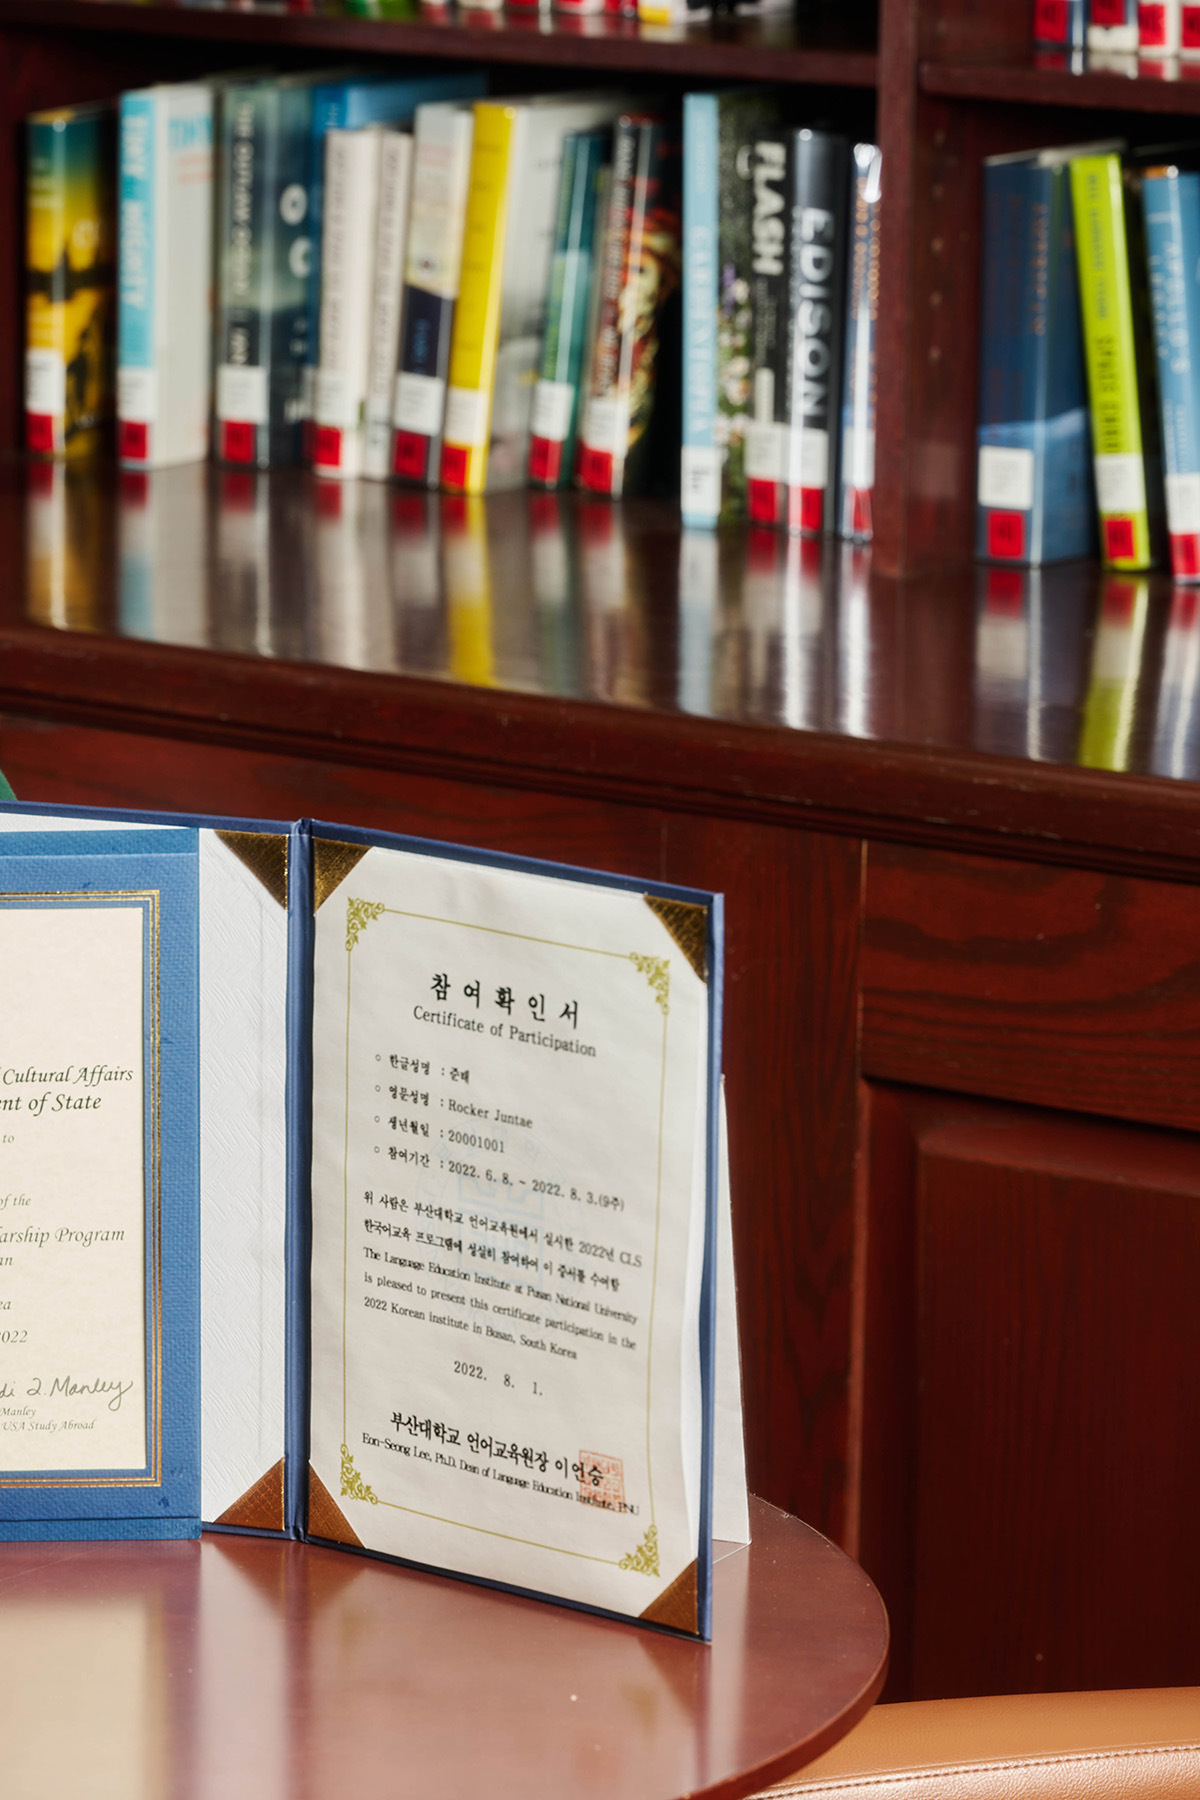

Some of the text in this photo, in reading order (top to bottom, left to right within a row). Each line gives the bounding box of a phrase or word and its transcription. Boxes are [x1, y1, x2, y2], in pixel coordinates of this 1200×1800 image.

[752, 141, 786, 276] FLASH
[796, 207, 834, 416] EDISON
[413, 1005, 596, 1057] Certificate of Participation
[3, 1065, 74, 1085] Cultural
[76, 1065, 133, 1087] Affairs
[28, 1092, 50, 1117] of
[51, 1094, 101, 1112] State
[448, 1099, 488, 1119] Rocker
[494, 1109, 533, 1128] Juntae
[3, 1135, 14, 1143] to
[388, 1116, 430, 1137] 생년월일
[448, 1129, 505, 1153] 20001001
[388, 1146, 430, 1168] 참여기간
[448, 1160, 480, 1178] 2022.
[485, 1169, 497, 1182] 6.
[502, 1172, 513, 1186] 8.
[532, 1180, 565, 1198] 2022.
[13, 1194, 31, 1206] the
[55, 1228, 124, 1247] Program
[364, 1191, 642, 1268] 위 사람은 부산대학교 언어교육원에서 실시한 2022년 CLS
[364, 1219, 411, 1241] 한국어교육
[415, 1231, 462, 1253] 프로그램에
[468, 1243, 495, 1261] 성실히
[544, 1260, 552, 1275] 이
[363, 1247, 380, 1260] The
[384, 1252, 425, 1271] Language
[428, 1262, 470, 1281] Education
[474, 1272, 510, 1292] Institute
[527, 1286, 551, 1300] Pusan
[555, 1293, 590, 1311] National
[594, 1303, 638, 1325] University
[364, 1272, 636, 1350] is pleased to present this certificate participation in the
[364, 1297, 577, 1360] 2022 Korean institute in Busan, South Korea
[50, 1376, 133, 1411] Manley
[453, 1360, 543, 1396] 2022. 8. 1.
[3, 1406, 36, 1418] Manley
[3, 1422, 25, 1430] USA
[28, 1420, 57, 1433] Study
[62, 1420, 95, 1429] Abroad
[390, 1411, 461, 1445] 부산대학교
[467, 1432, 549, 1472] 언어교육원장
[362, 1432, 410, 1456] Eon-Seong
[413, 1445, 432, 1462] Lee,
[460, 1460, 479, 1474] Dean
[482, 1467, 490, 1477] of
[492, 1469, 530, 1489] Language
[533, 1480, 573, 1500] Education
